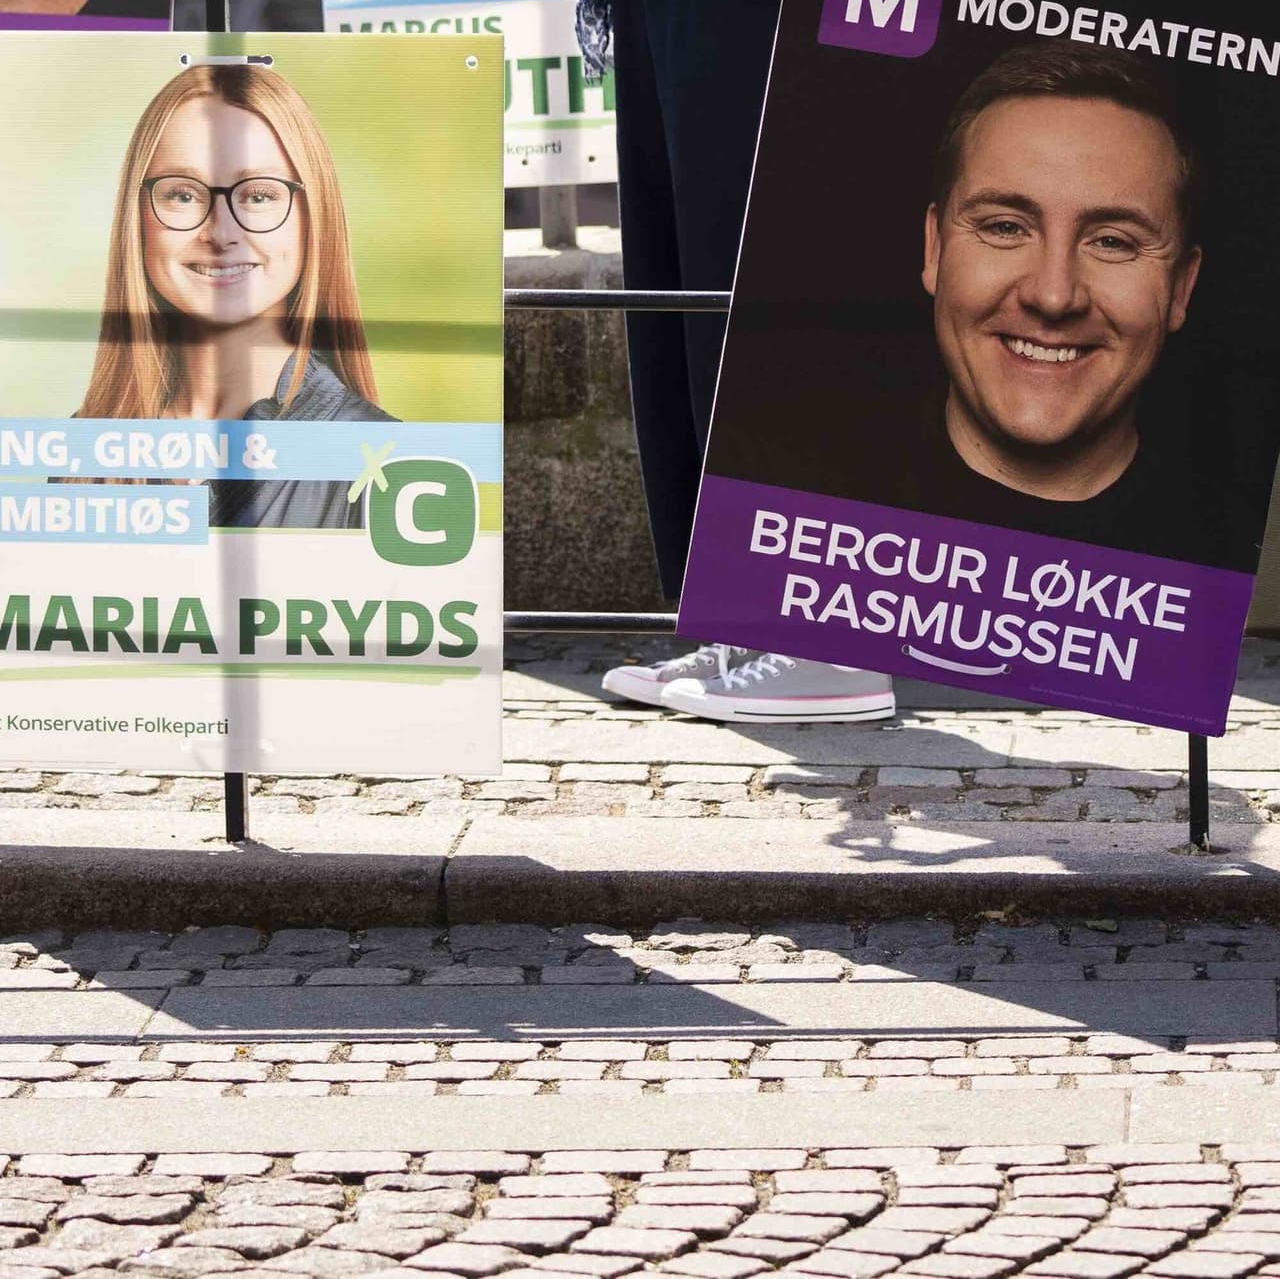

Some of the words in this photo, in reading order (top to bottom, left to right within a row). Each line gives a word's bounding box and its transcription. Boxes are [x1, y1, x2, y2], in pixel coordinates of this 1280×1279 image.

[506, 140, 562, 156] keparti
[94, 430, 229, 470] GRØN
[242, 433, 278, 470] &
[395, 481, 447, 545] C
[748, 509, 988, 594] BERGUR
[1002, 555, 1192, 633] LØKKE
[238, 598, 479, 659] PRYDS
[779, 572, 1139, 682] RASMUSSEN
[6, 713, 129, 733] Konservative
[134, 716, 229, 739] Folkeparti
